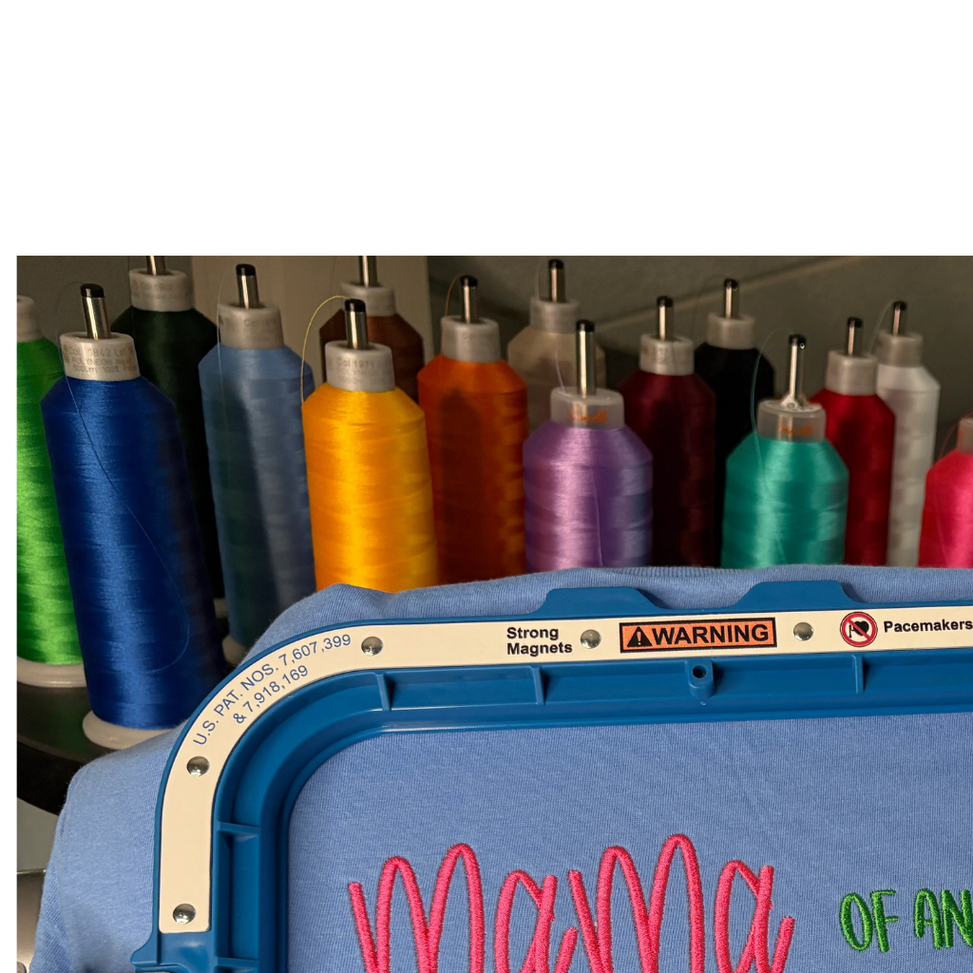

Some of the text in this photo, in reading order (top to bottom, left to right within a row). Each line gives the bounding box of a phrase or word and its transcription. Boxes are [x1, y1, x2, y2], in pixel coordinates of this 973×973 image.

[506, 626, 559, 641] Strong
[652, 623, 770, 645] WARNING
[883, 619, 973, 633] Pacemakers
[507, 641, 573, 657] Magnets
[193, 634, 351, 746] U.S. PAT. NOS. 7,607,399
[232, 665, 309, 724] & 7,918,169
[840, 889, 899, 952] OF
